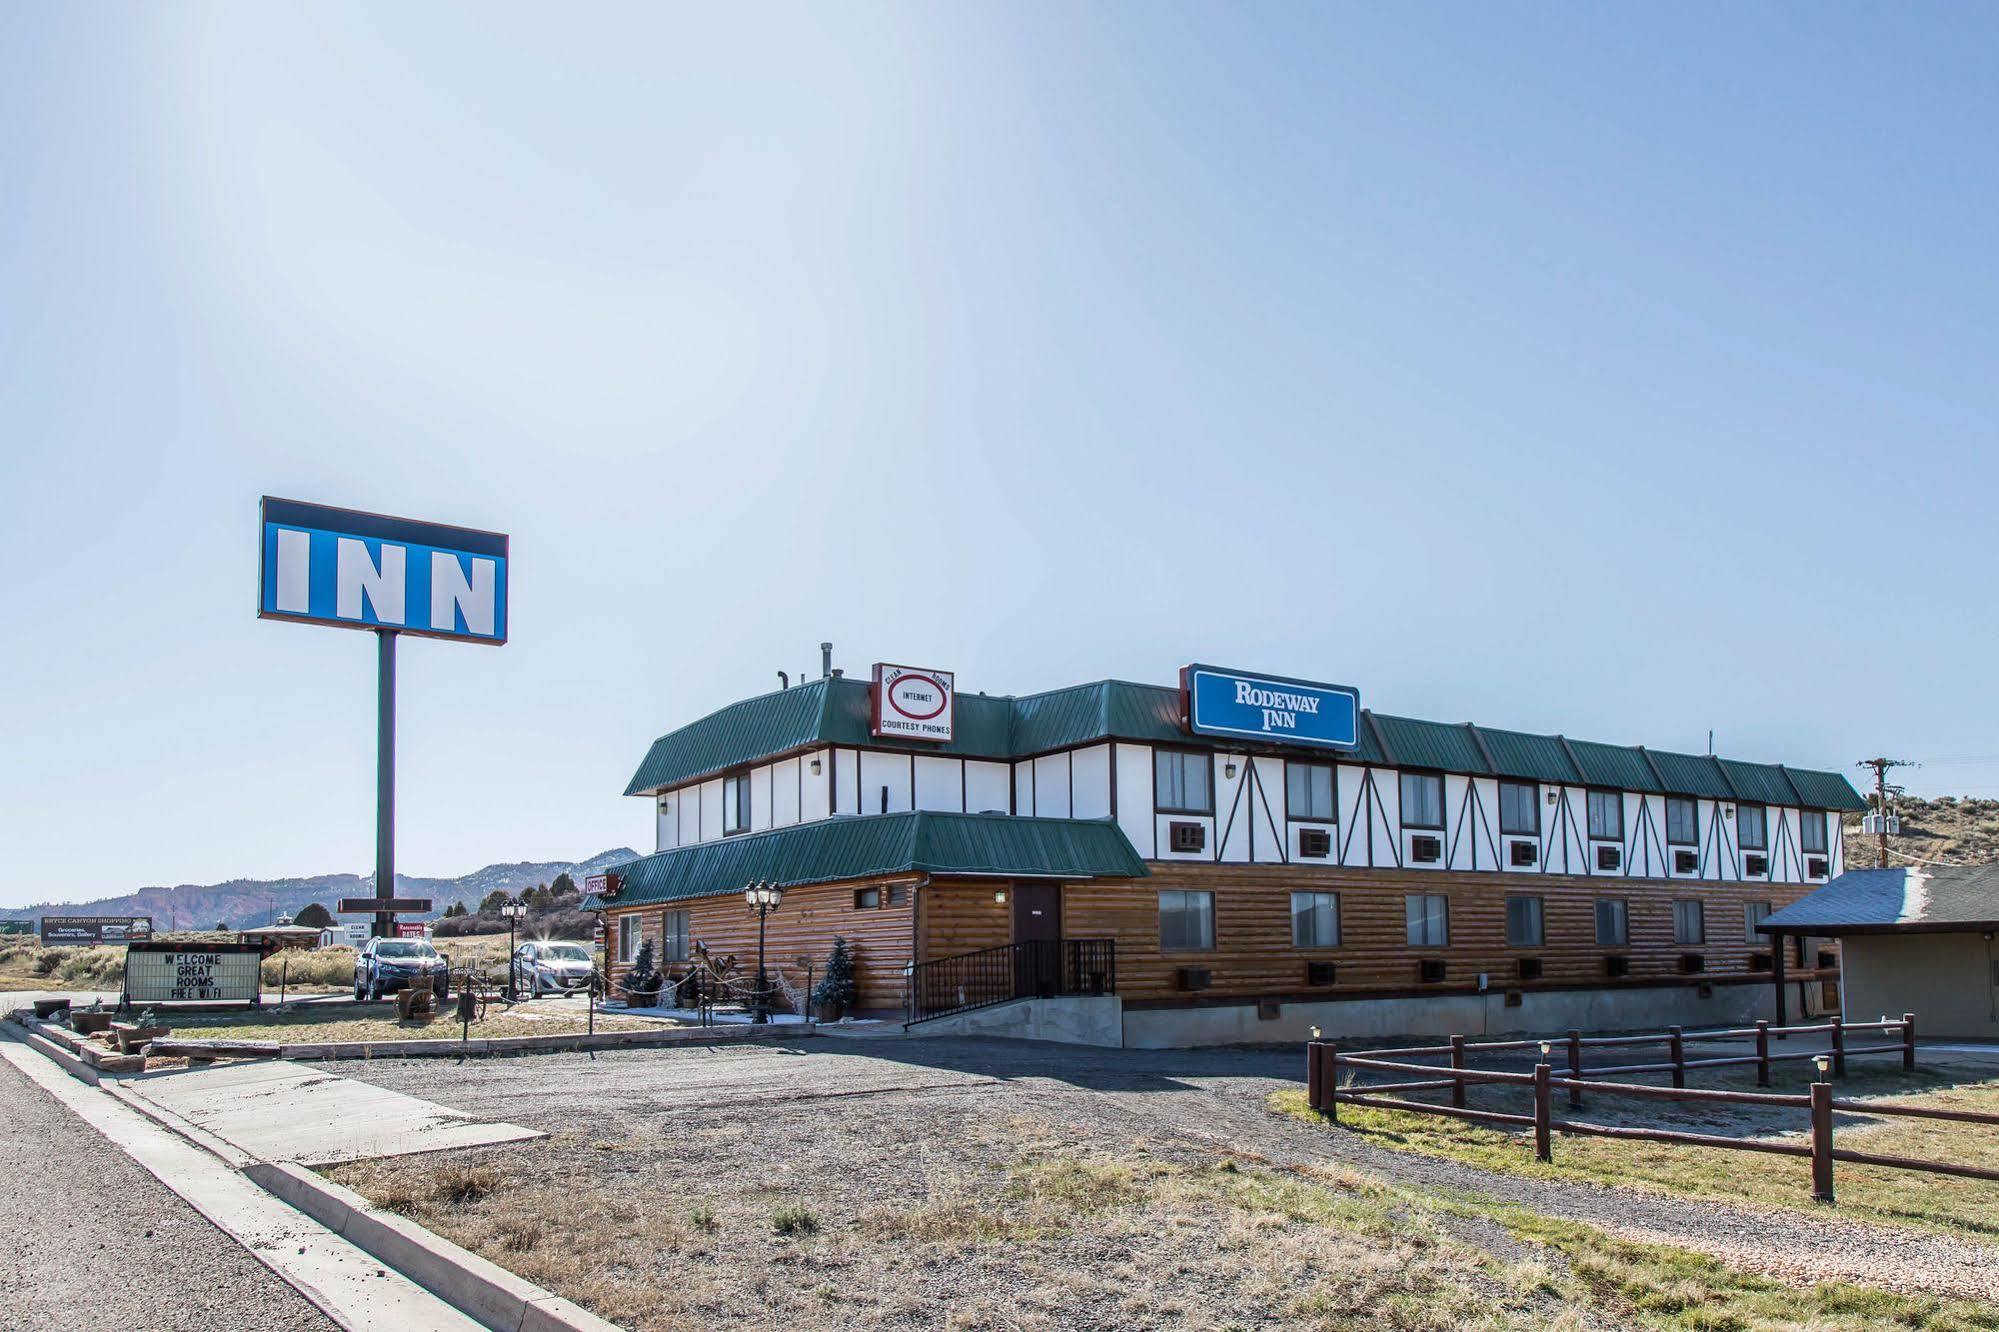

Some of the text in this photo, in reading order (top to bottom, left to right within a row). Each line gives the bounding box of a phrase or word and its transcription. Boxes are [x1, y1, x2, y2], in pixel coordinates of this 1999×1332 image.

[276, 528, 495, 635] INN
[885, 669, 902, 685] CLEAN
[931, 673, 950, 691] ROOMS
[903, 692, 932, 702] INTERNET
[1235, 681, 1319, 714] RODEWAY
[1262, 709, 1296, 730] INN
[882, 720, 950, 735] COURTESY PHONES
[588, 879, 606, 892] OFFICE
[165, 954, 221, 965] WELCOME
[178, 966, 212, 976] GREAT
[177, 977, 214, 987] ROOMS
[171, 988, 193, 998] FREE
